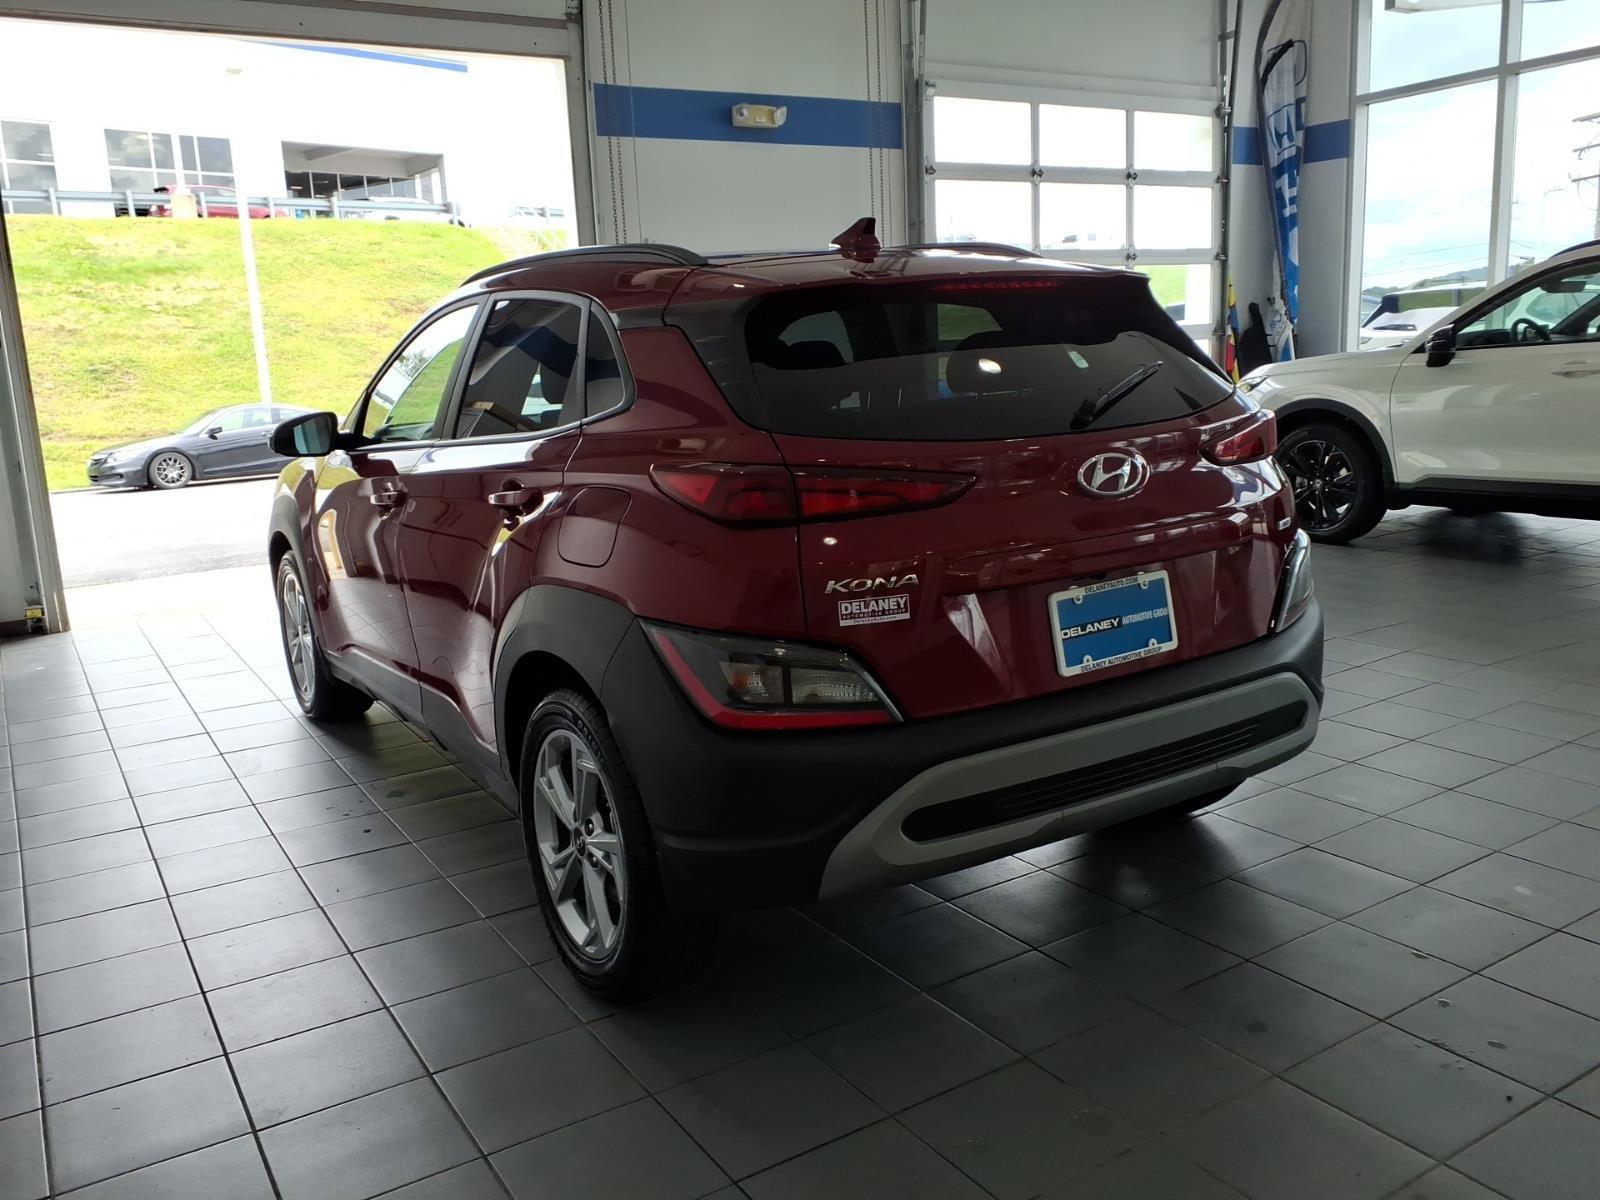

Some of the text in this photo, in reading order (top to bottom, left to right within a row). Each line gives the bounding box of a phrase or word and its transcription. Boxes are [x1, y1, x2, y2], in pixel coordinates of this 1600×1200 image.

[824, 574, 919, 594] KONA
[841, 596, 907, 615] DELANEY
[1060, 617, 1120, 639] DELANEY
[1122, 611, 1152, 625] AUTOMOTIVE
[1081, 646, 1162, 673] DELANEY AUTOMOTIVE GROUP
